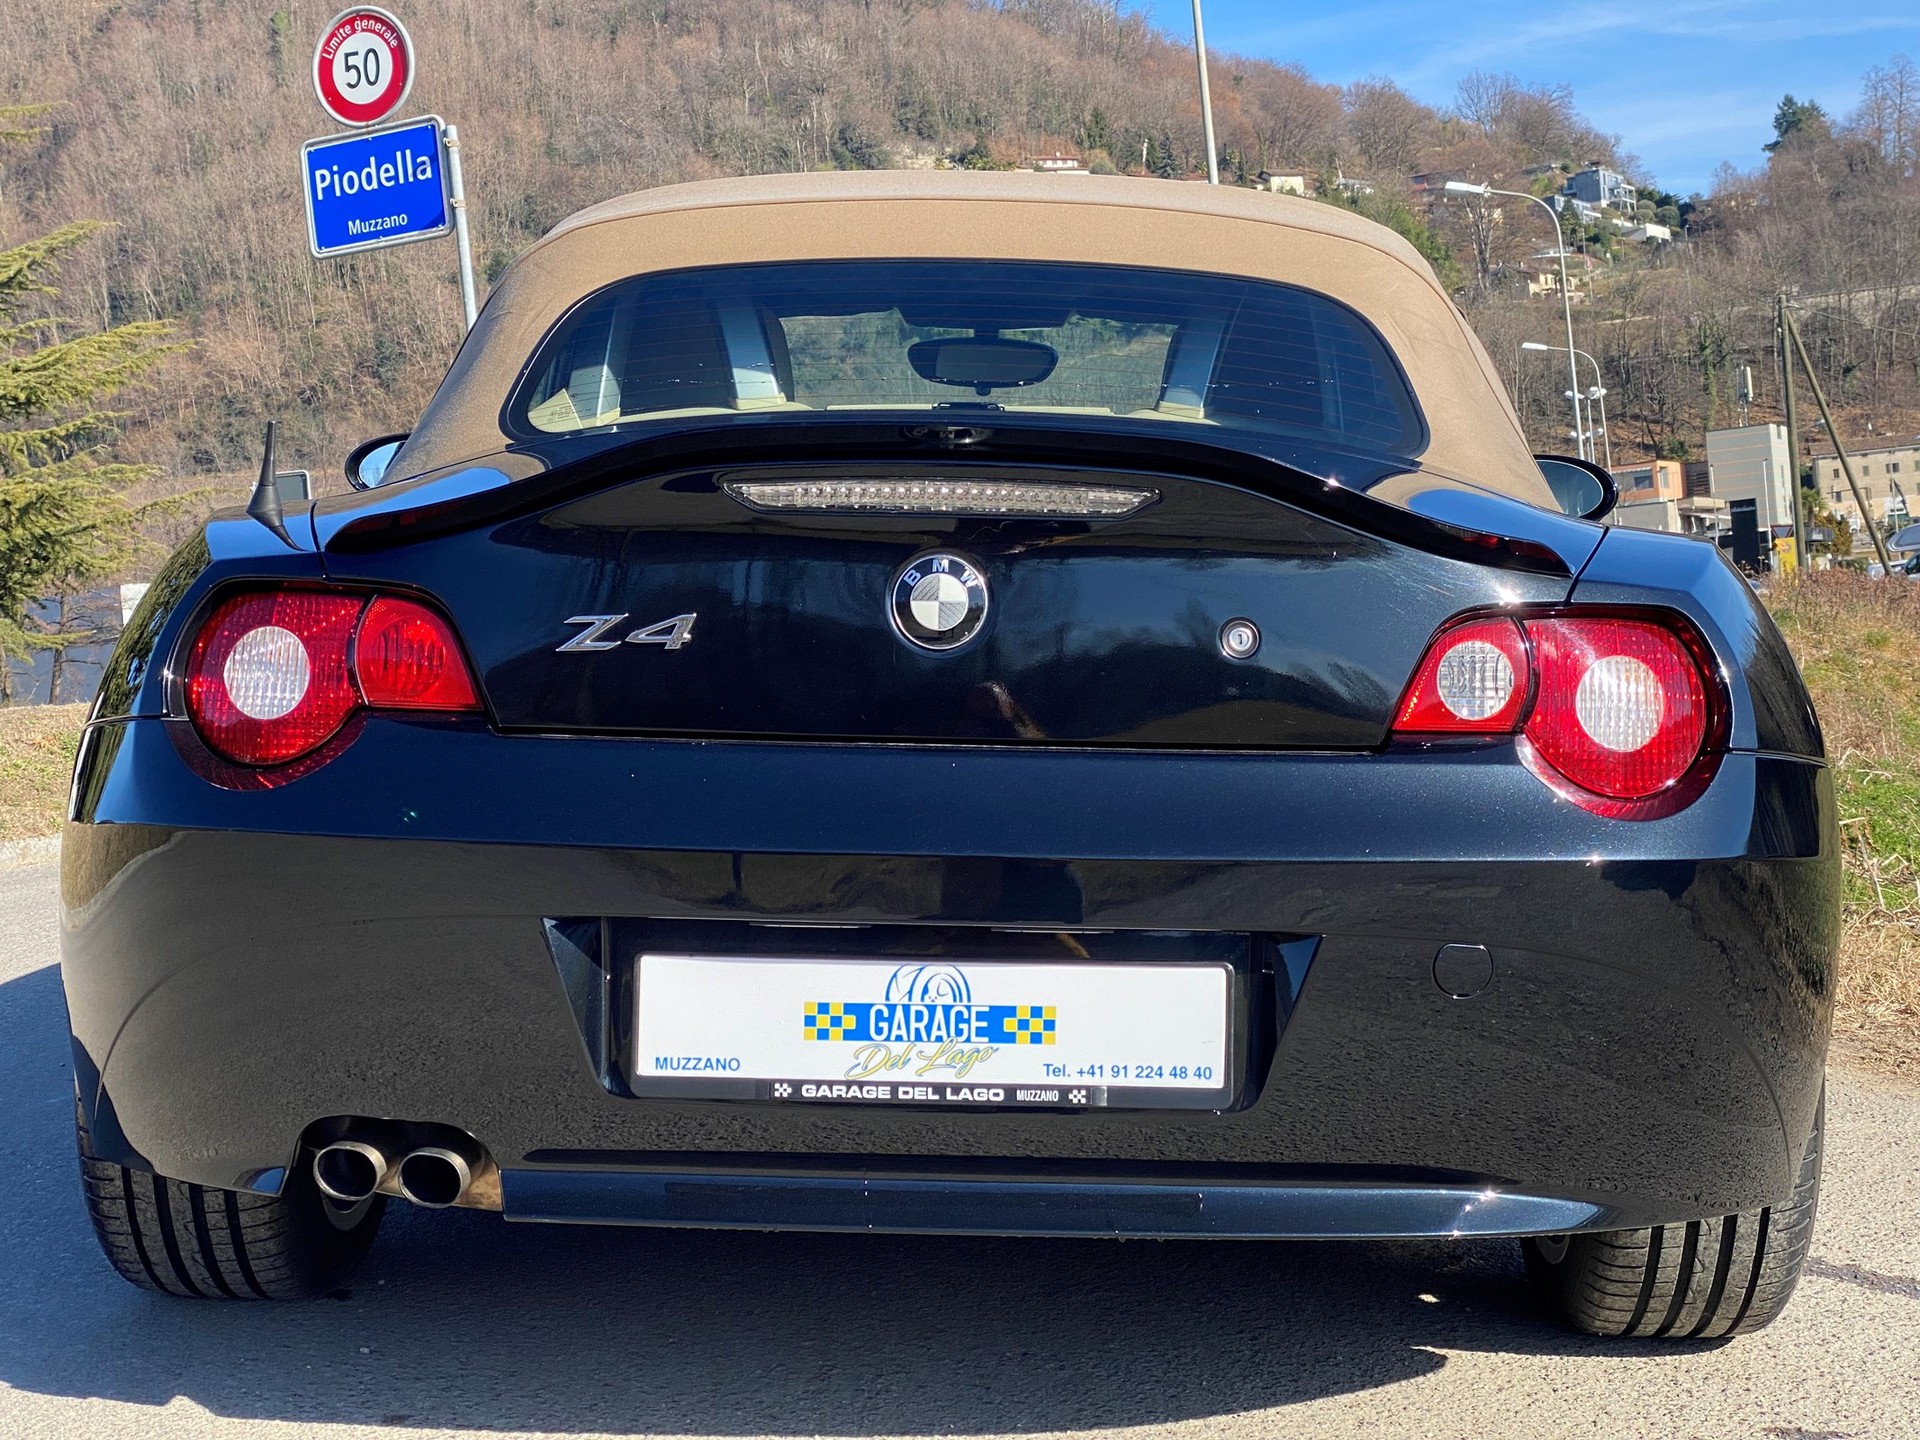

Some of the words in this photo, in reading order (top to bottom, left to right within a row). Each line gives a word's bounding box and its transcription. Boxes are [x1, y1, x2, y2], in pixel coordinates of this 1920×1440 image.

[322, 24, 352, 60] Limite
[354, 18, 398, 49] generale
[343, 47, 380, 89] 50
[314, 148, 433, 201] Piodella
[347, 212, 408, 236] Muzzano
[903, 558, 979, 588] BMW
[556, 613, 697, 651] Z4
[869, 1004, 990, 1042] GARAGE
[655, 1057, 741, 1072] MUZZANO
[844, 1043, 916, 1080] Del
[915, 1036, 999, 1079] Lago
[1043, 1063, 1071, 1077] Tel.
[1076, 1064, 1104, 1078] +41
[1111, 1065, 1128, 1079] 91
[1135, 1065, 1164, 1080] 224
[1169, 1066, 1188, 1080] 48
[1193, 1066, 1213, 1080] 40
[801, 1084, 891, 1099] GARAGE
[898, 1086, 940, 1100] DEL
[945, 1087, 1005, 1101] LAGO
[1016, 1089, 1059, 1102] MUZZANO
